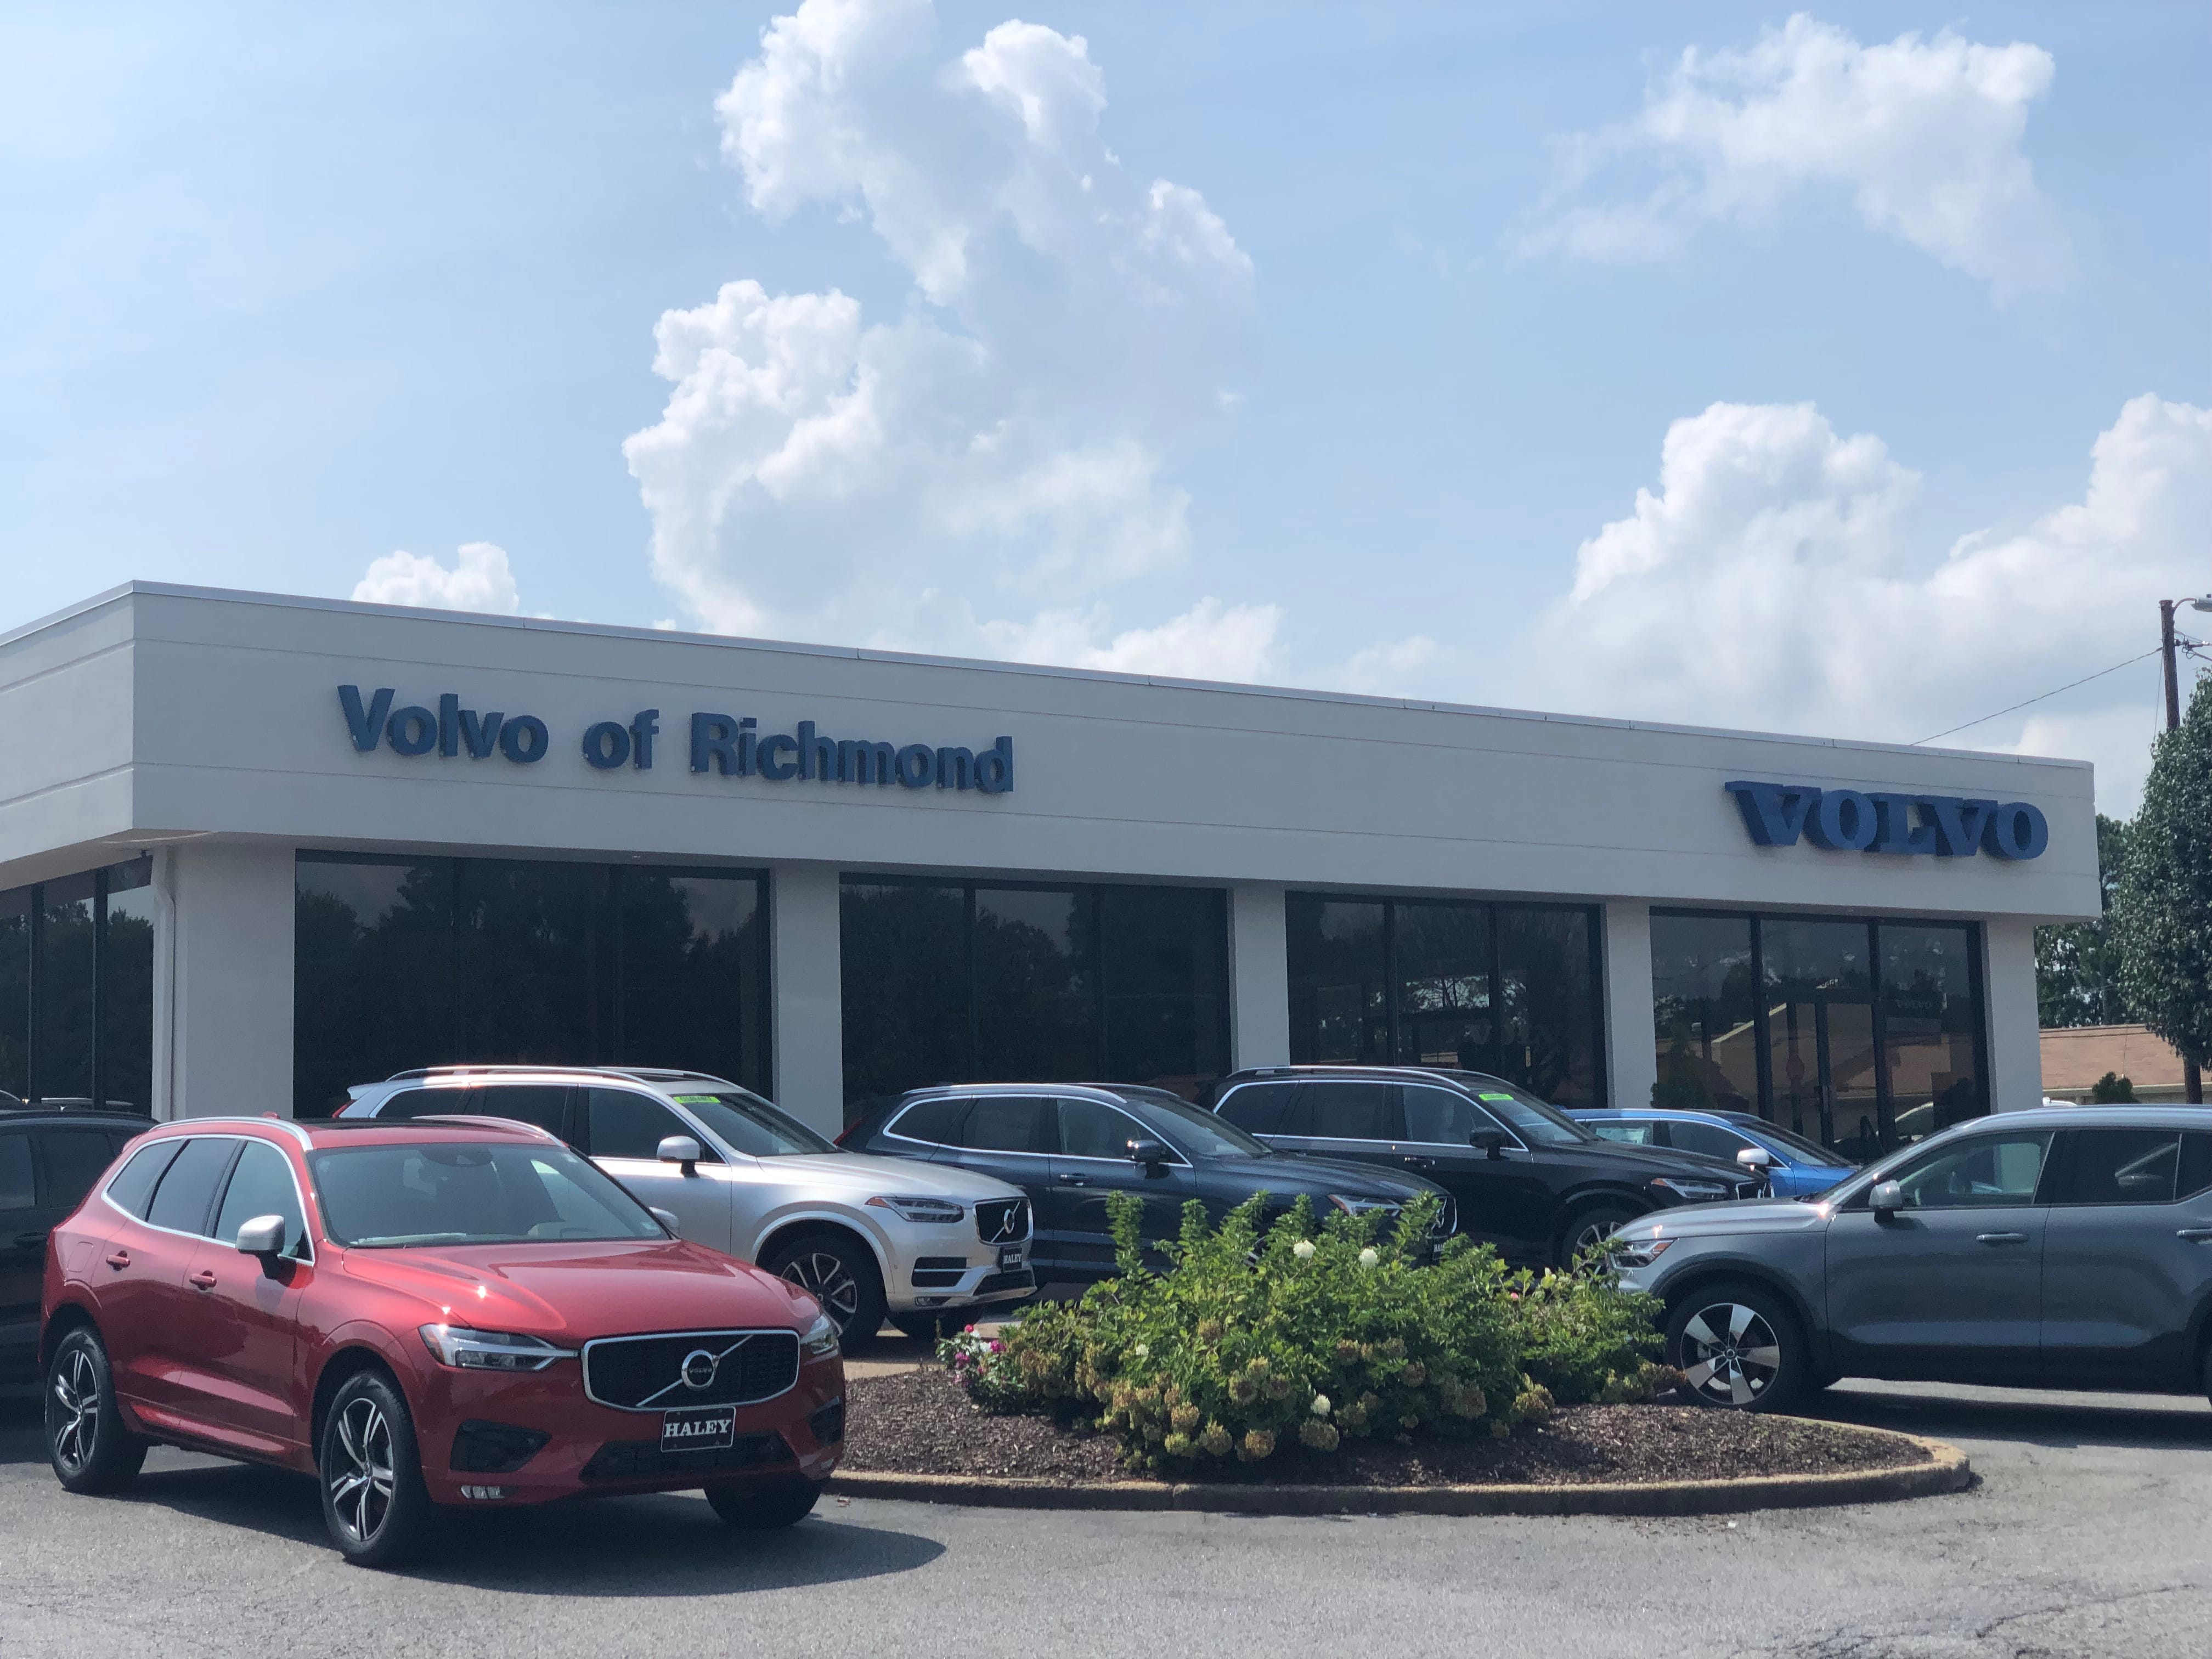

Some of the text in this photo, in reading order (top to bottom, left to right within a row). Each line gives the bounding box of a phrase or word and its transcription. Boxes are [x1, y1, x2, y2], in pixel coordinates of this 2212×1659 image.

[336, 685, 1014, 793] Volvo of Richmond
[1725, 780, 2049, 860] VOLVO
[1004, 1254, 1022, 1263] HALEY
[664, 1420, 731, 1437] HALEY
